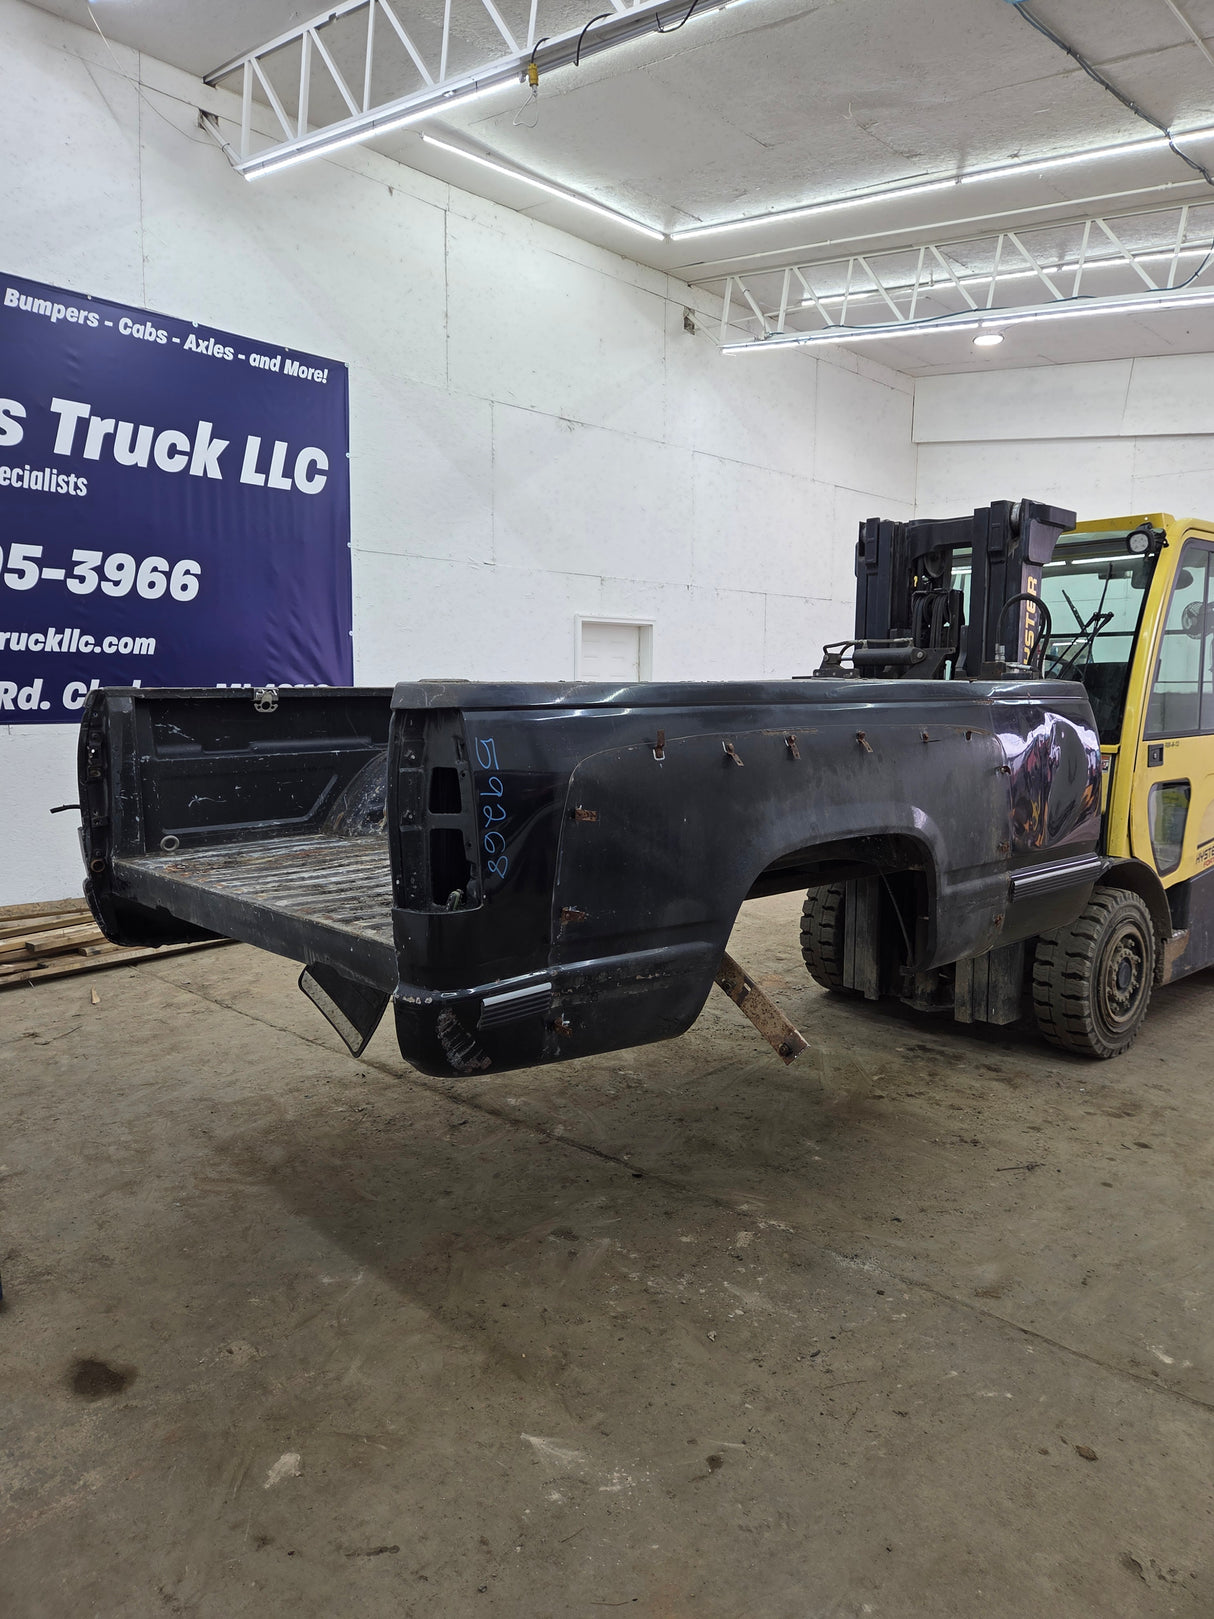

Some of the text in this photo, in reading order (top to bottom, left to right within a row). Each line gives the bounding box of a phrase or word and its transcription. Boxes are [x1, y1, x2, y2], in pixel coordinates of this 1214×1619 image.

[4, 287, 100, 329] Bumpers
[118, 317, 168, 345] Cabs
[183, 333, 235, 362] Axles
[249, 352, 282, 373] and
[283, 358, 329, 384] More!
[50, 397, 230, 480] Truck
[240, 435, 329, 495] LLC
[0, 464, 88, 497] ecialists
[0, 542, 202, 602] 5-3966
[0, 627, 156, 655] ruckllc.com
[0, 678, 51, 711] Rd.
[475, 737, 508, 879] 59268
